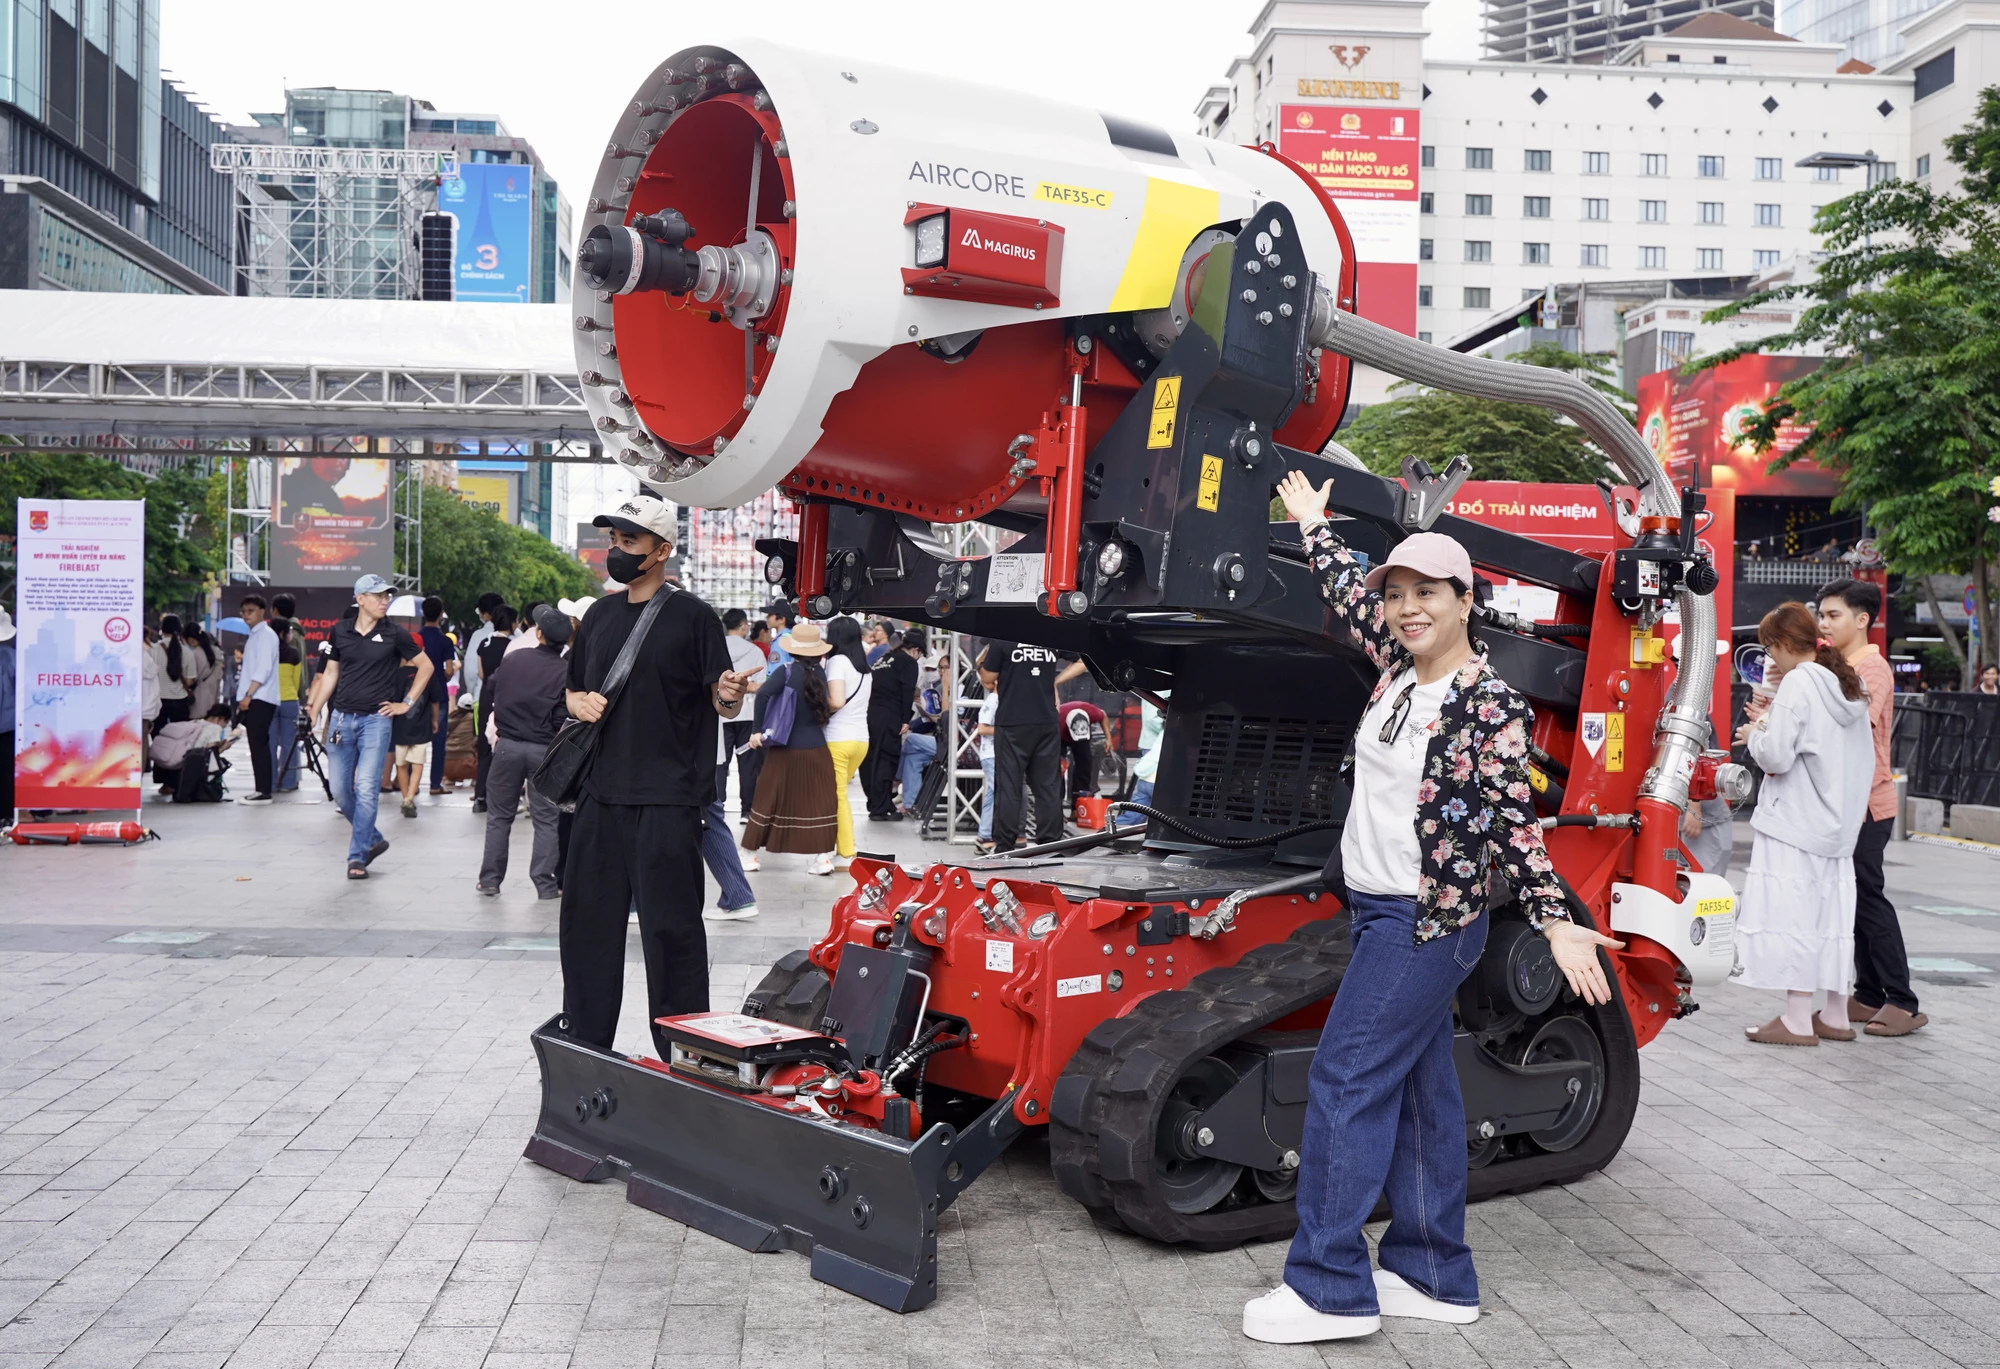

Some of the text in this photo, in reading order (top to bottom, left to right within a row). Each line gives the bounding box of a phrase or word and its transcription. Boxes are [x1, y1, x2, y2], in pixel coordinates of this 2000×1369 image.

[1297, 79, 1400, 100] SAIGON PRINCE
[908, 160, 1026, 198] AIRCORE
[1346, 164, 1373, 176] HỌC
[1043, 185, 1106, 207] TAF35-C
[475, 244, 498, 271] 3
[984, 239, 1036, 261] MAGIRUS
[1459, 499, 1484, 515] ĐỒ
[1488, 501, 1525, 516] TRẢI
[1530, 503, 1597, 520] NGHIỆM
[59, 563, 100, 572] FIREBLAST
[1011, 648, 1057, 663] CREW
[37, 673, 125, 687] FIREBLAST
[1699, 900, 1730, 913] TAF35-C
